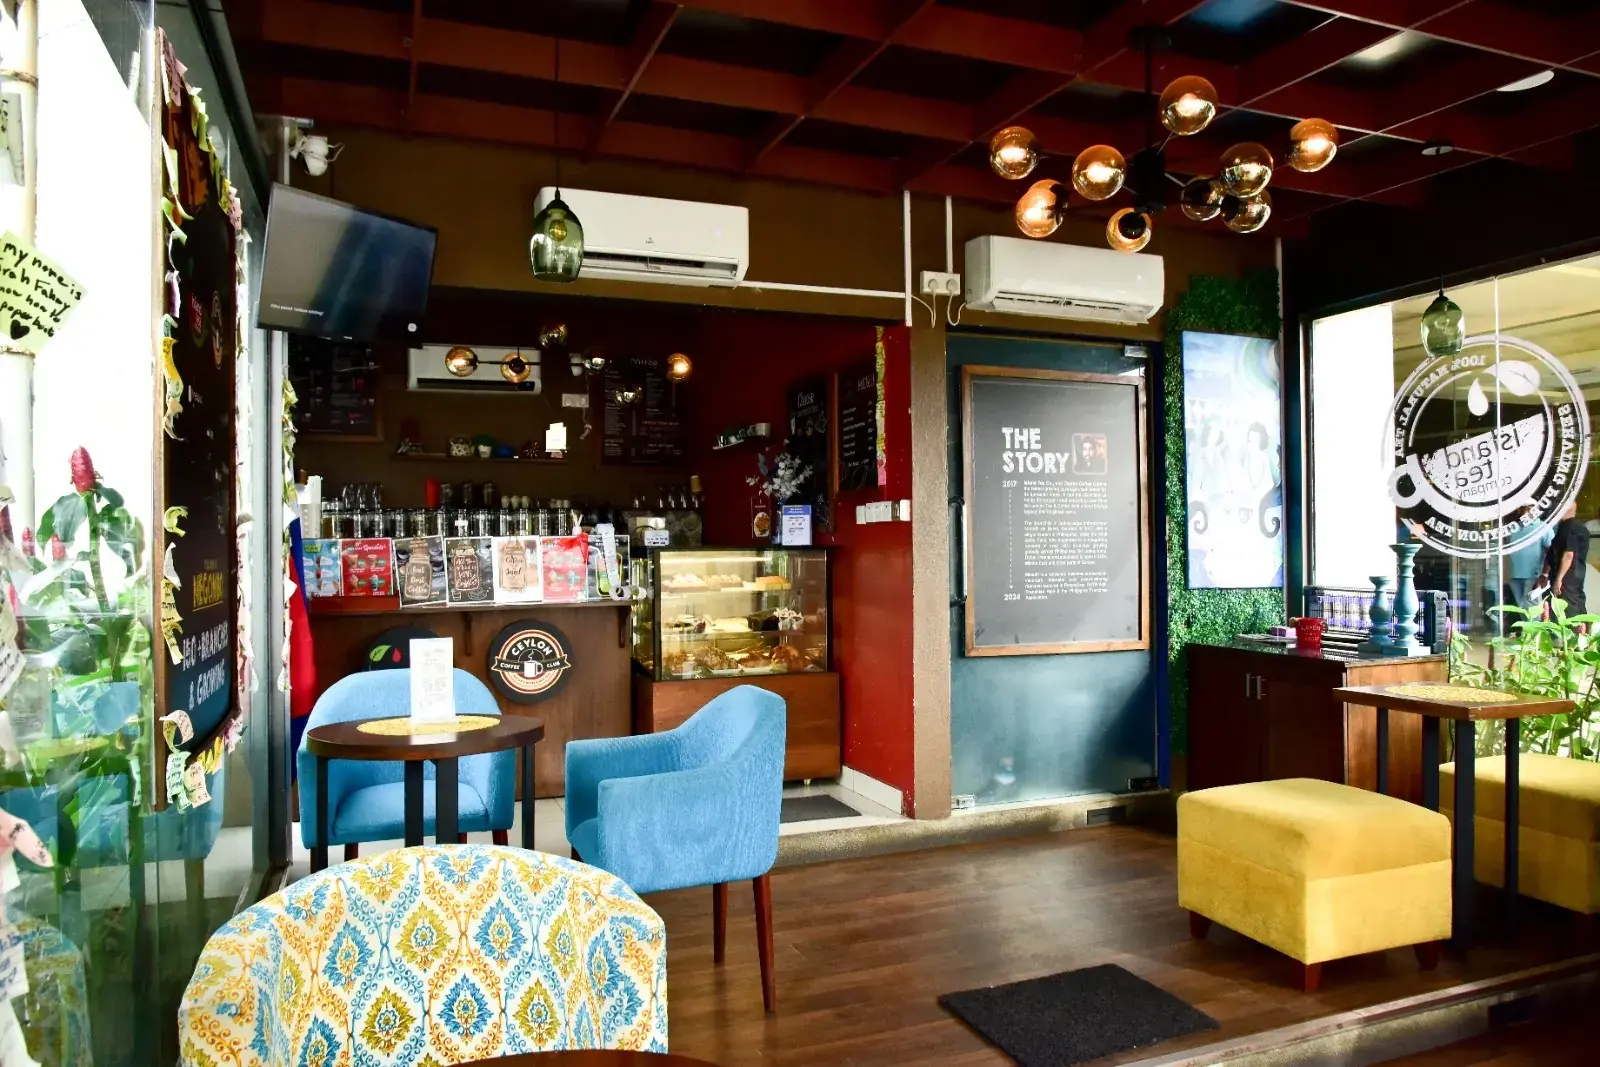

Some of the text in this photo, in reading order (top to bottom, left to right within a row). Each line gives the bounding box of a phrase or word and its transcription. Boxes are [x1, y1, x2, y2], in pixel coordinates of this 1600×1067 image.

[3, 243, 28, 267] my
[1001, 427, 1042, 450] THE
[1002, 451, 1070, 474] STORY
[511, 638, 553, 656] CEYLON
